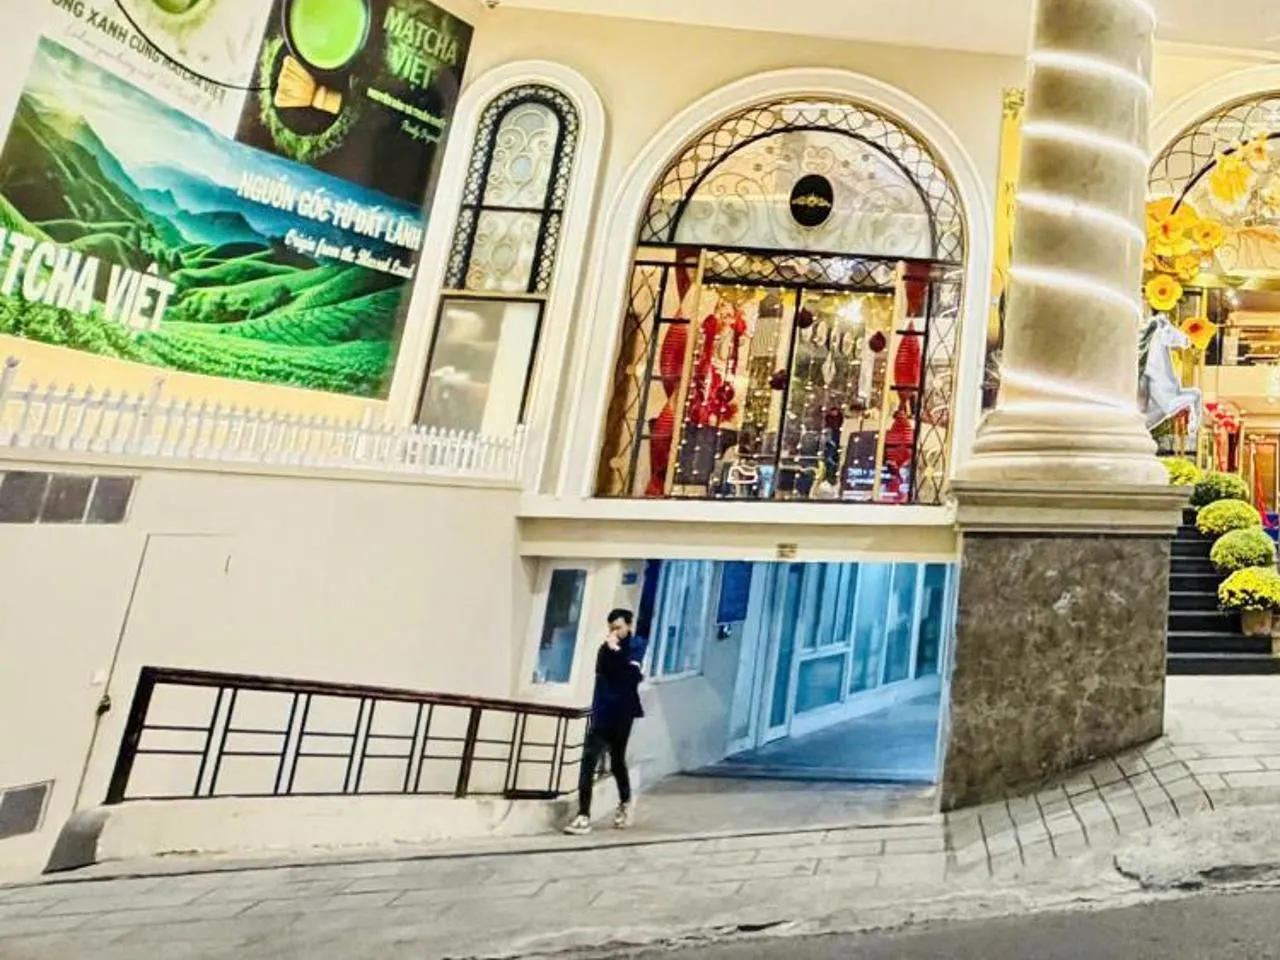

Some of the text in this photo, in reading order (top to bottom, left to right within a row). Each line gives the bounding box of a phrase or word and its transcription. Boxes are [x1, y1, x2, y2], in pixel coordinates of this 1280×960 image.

[86, 7, 128, 45] XANH
[383, 5, 459, 66] MATCHA
[0, 226, 100, 315] TCHA
